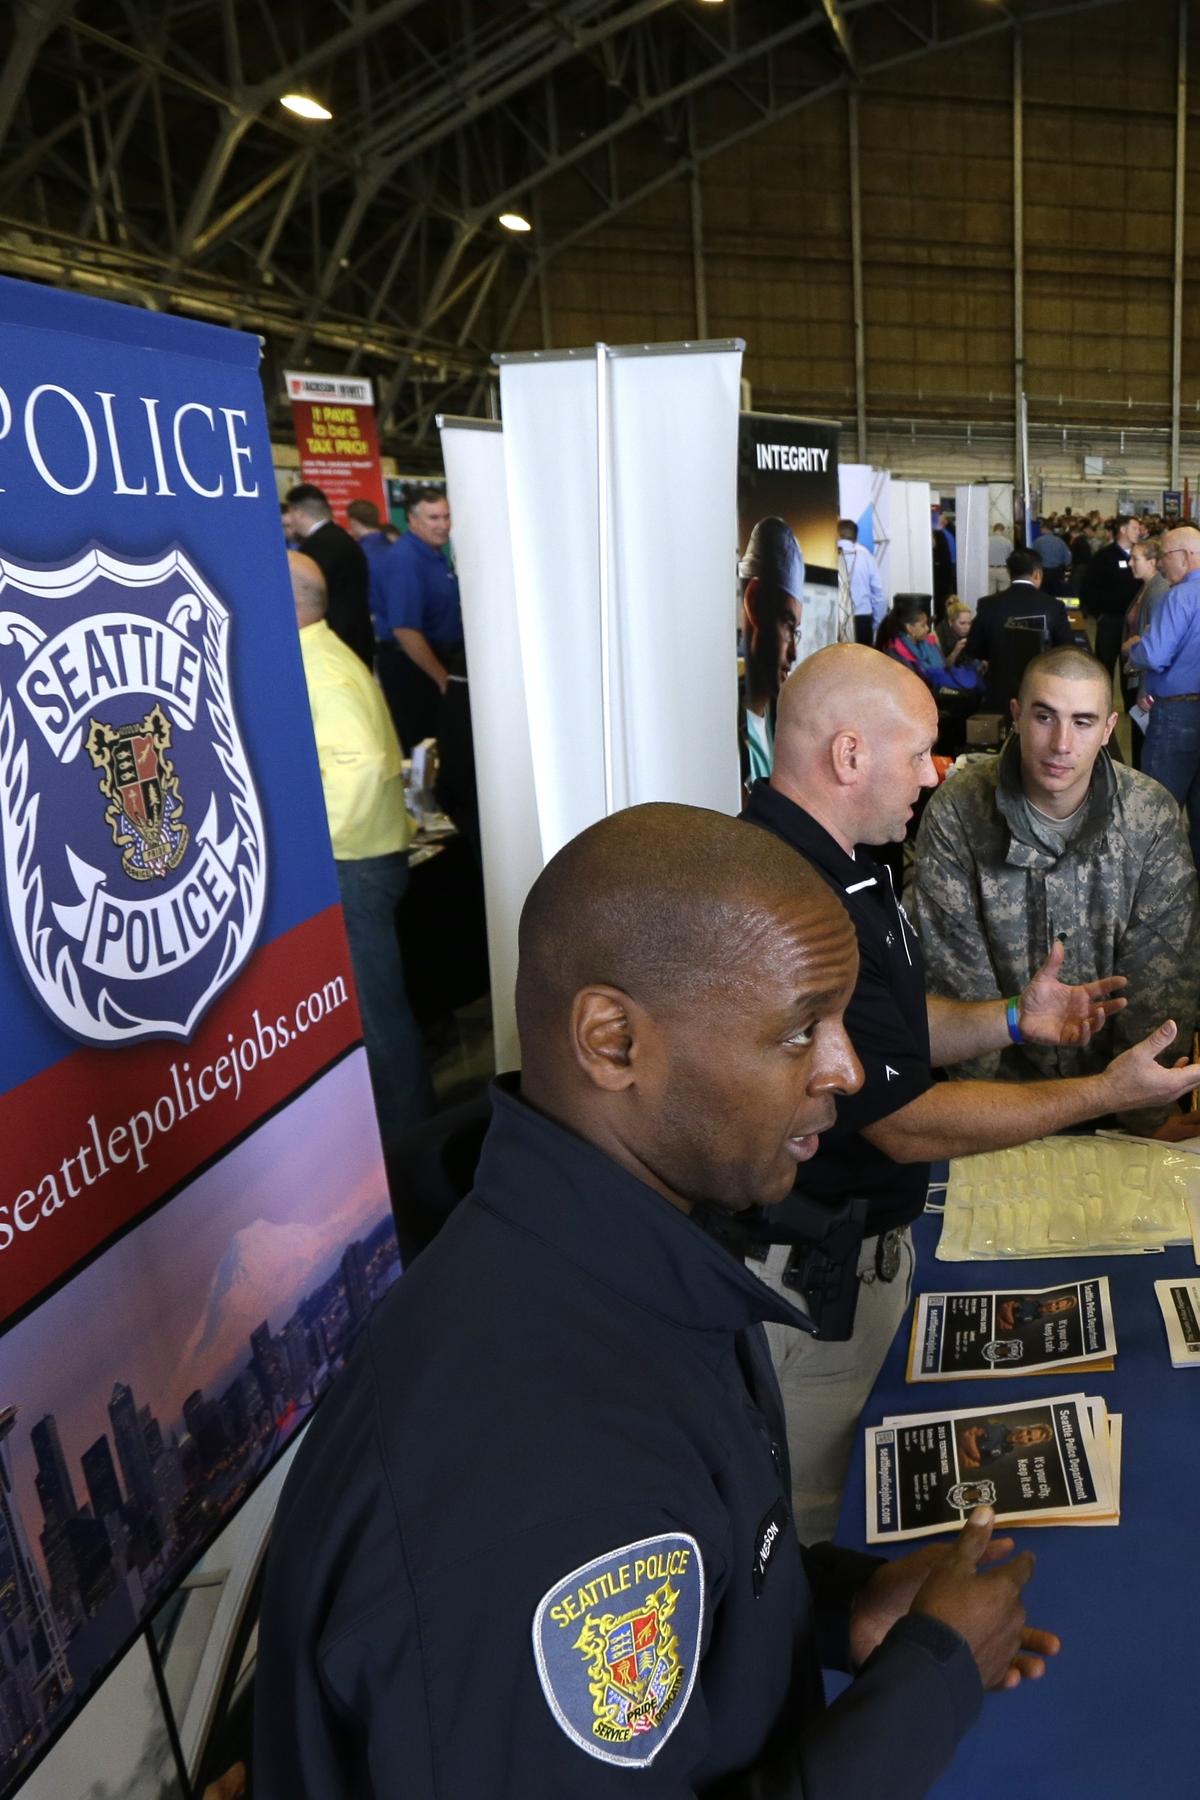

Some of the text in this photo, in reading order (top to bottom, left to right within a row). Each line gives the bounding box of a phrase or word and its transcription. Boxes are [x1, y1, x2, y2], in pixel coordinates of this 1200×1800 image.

[323, 407, 357, 423] PAYS
[306, 438, 334, 454] TAX
[756, 444, 829, 472] INTEGRITY
[26, 624, 198, 734] SEATTLE
[96, 863, 231, 972] POLICE
[0, 975, 348, 1250] seattlepolicejobs.com
[1087, 1302, 1095, 1317] Police
[1035, 1457, 1044, 1467] It's
[1060, 1411, 1086, 1498] Seattle Police Department
[1018, 1459, 1027, 1475] Keep
[1034, 1469, 1045, 1482] your
[880, 1449, 891, 1523] seattlepolicejobs.com
[1022, 1484, 1033, 1497] safe
[550, 1550, 690, 1628] SEATTLE POLICE
[627, 1697, 658, 1722] PRIDE
[594, 1722, 630, 1741] SERVICE
